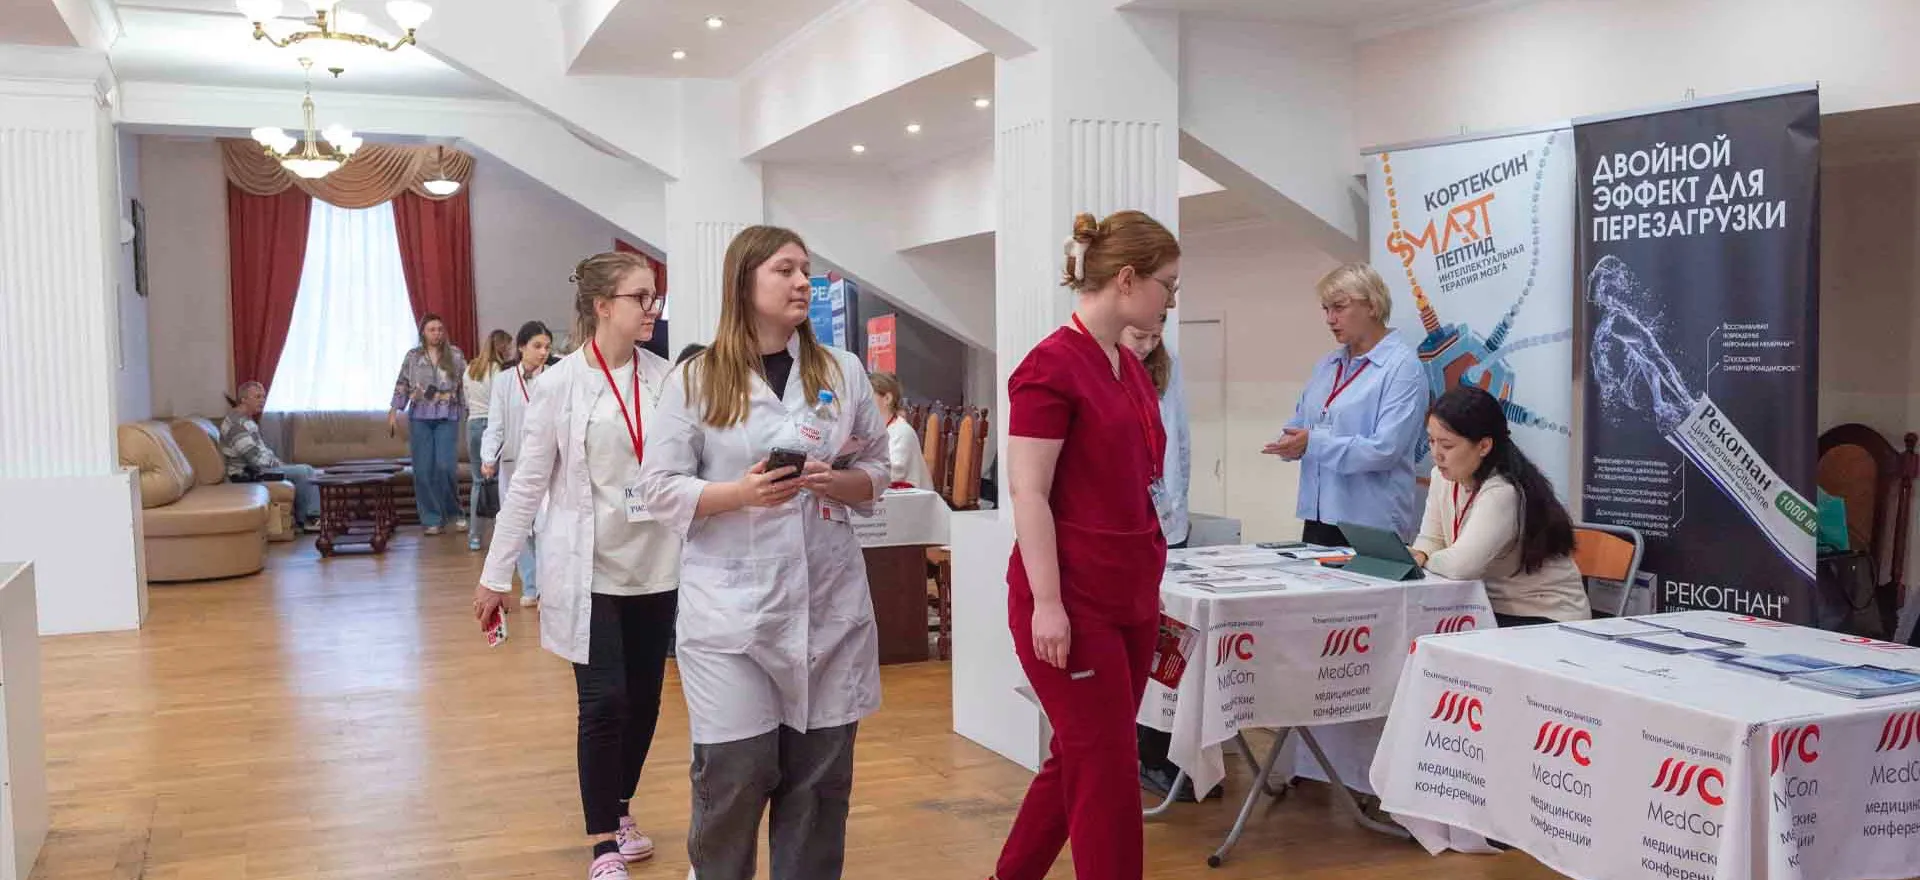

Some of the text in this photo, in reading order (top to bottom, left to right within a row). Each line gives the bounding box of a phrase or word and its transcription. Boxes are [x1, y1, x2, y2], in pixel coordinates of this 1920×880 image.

[1593, 133, 1731, 185] ДВОЙНОЙ
[1424, 153, 1528, 212] КОРТЕКСИН
[1593, 169, 1764, 212] ЭФФЕКТ ДЛЯ
[1387, 192, 1496, 268] SMART
[1593, 200, 1786, 242] ПЕРЕЗАГРУЗКИ
[1435, 236, 1496, 271] ПЕПТИД
[1438, 244, 1525, 283] ИНТЕЛЛЕКТУАЛЬНАЯ
[1440, 262, 1508, 294] ТЕРАПИЯ МОЗГА
[1699, 404, 1772, 491] Рекогнан
[1778, 493, 1807, 524] 1000
[1318, 662, 1370, 680] MedCon
[1313, 702, 1371, 718] конференции
[1314, 686, 1371, 703] медицинские
[1425, 730, 1484, 763] MedCon
[1686, 745, 1732, 766] организато
[1418, 761, 1486, 788] медицинские
[1532, 761, 1592, 799] MedCon
[1870, 759, 1920, 786] MedC
[1415, 782, 1486, 807] конференции
[1865, 799, 1920, 816] медицин
